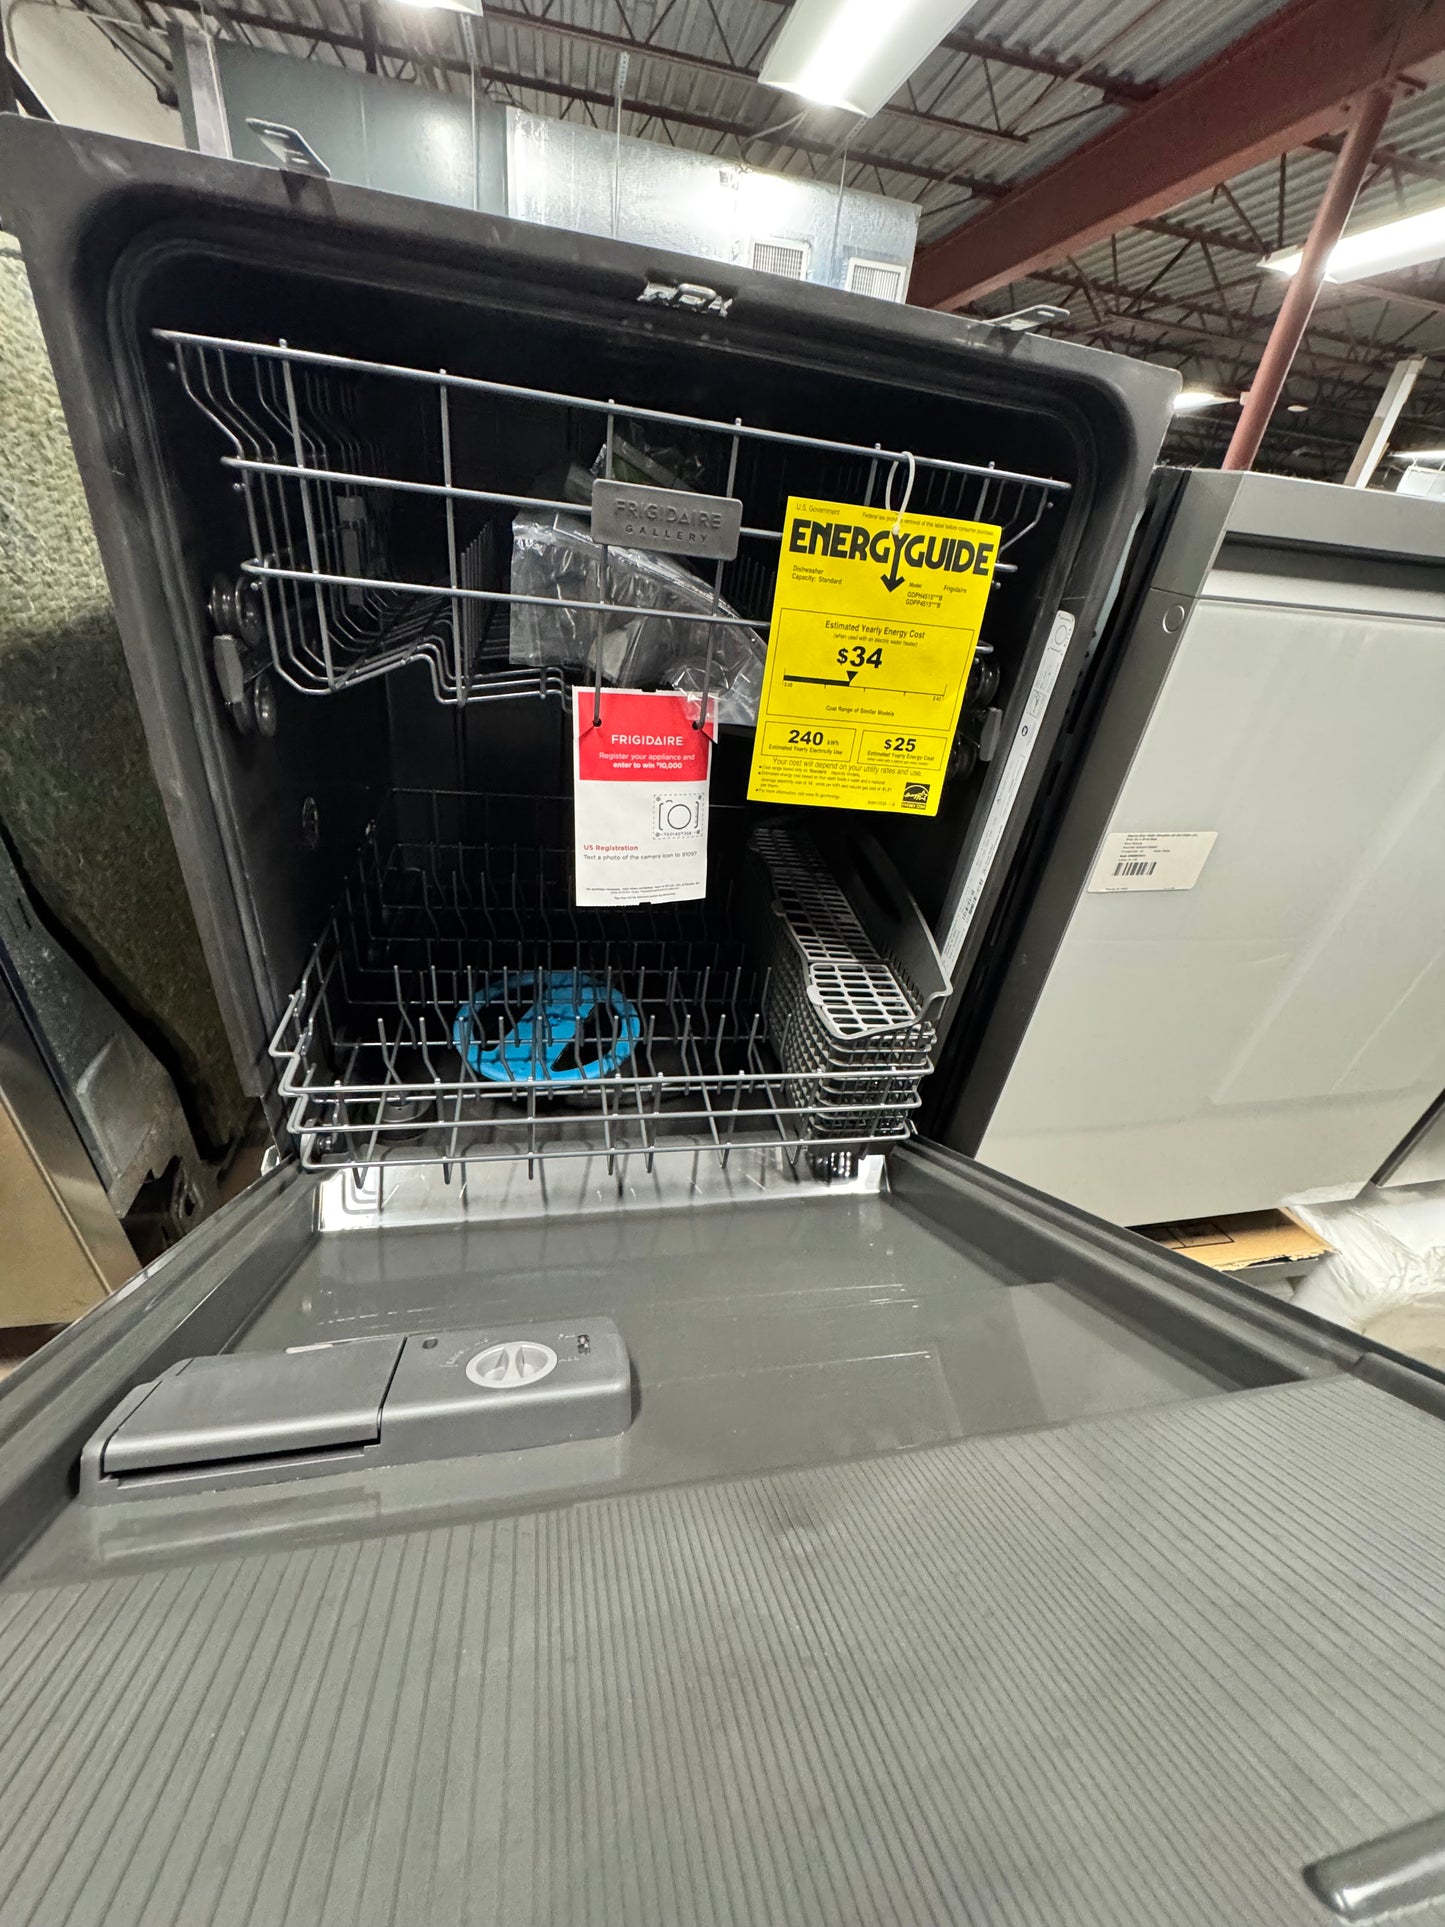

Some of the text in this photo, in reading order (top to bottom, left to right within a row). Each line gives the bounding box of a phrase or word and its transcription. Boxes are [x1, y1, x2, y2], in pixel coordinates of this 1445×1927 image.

[615, 497, 722, 530] FRIGIDAIRE
[796, 503, 841, 516] U.S. Government
[625, 524, 709, 545] GALLERY
[789, 518, 995, 584] ENERGYGUIDE
[793, 564, 825, 575] Dishwasher
[791, 572, 843, 585] Capacity: Standard
[943, 584, 967, 594] Frigidaire
[825, 620, 926, 640] Estimated Yearly Energy Cost
[836, 645, 883, 669] $34
[611, 734, 684, 746] FRIGIDAIRE
[787, 729, 824, 746] 240
[793, 745, 809, 753] Yearly
[809, 747, 832, 755] Electricity
[884, 737, 917, 753] $25
[598, 752, 629, 761] Register
[648, 753, 682, 761] appliance
[682, 753, 696, 761] and
[867, 750, 890, 758] Estimated
[891, 752, 906, 760] Yearly
[906, 753, 923, 761] Energy
[612, 761, 632, 769] enter
[656, 761, 683, 770] $10,000
[814, 762, 838, 770] depend
[863, 766, 880, 775] utility
[896, 768, 909, 776] and
[595, 844, 639, 852] Registration
[602, 854, 621, 862] photo
